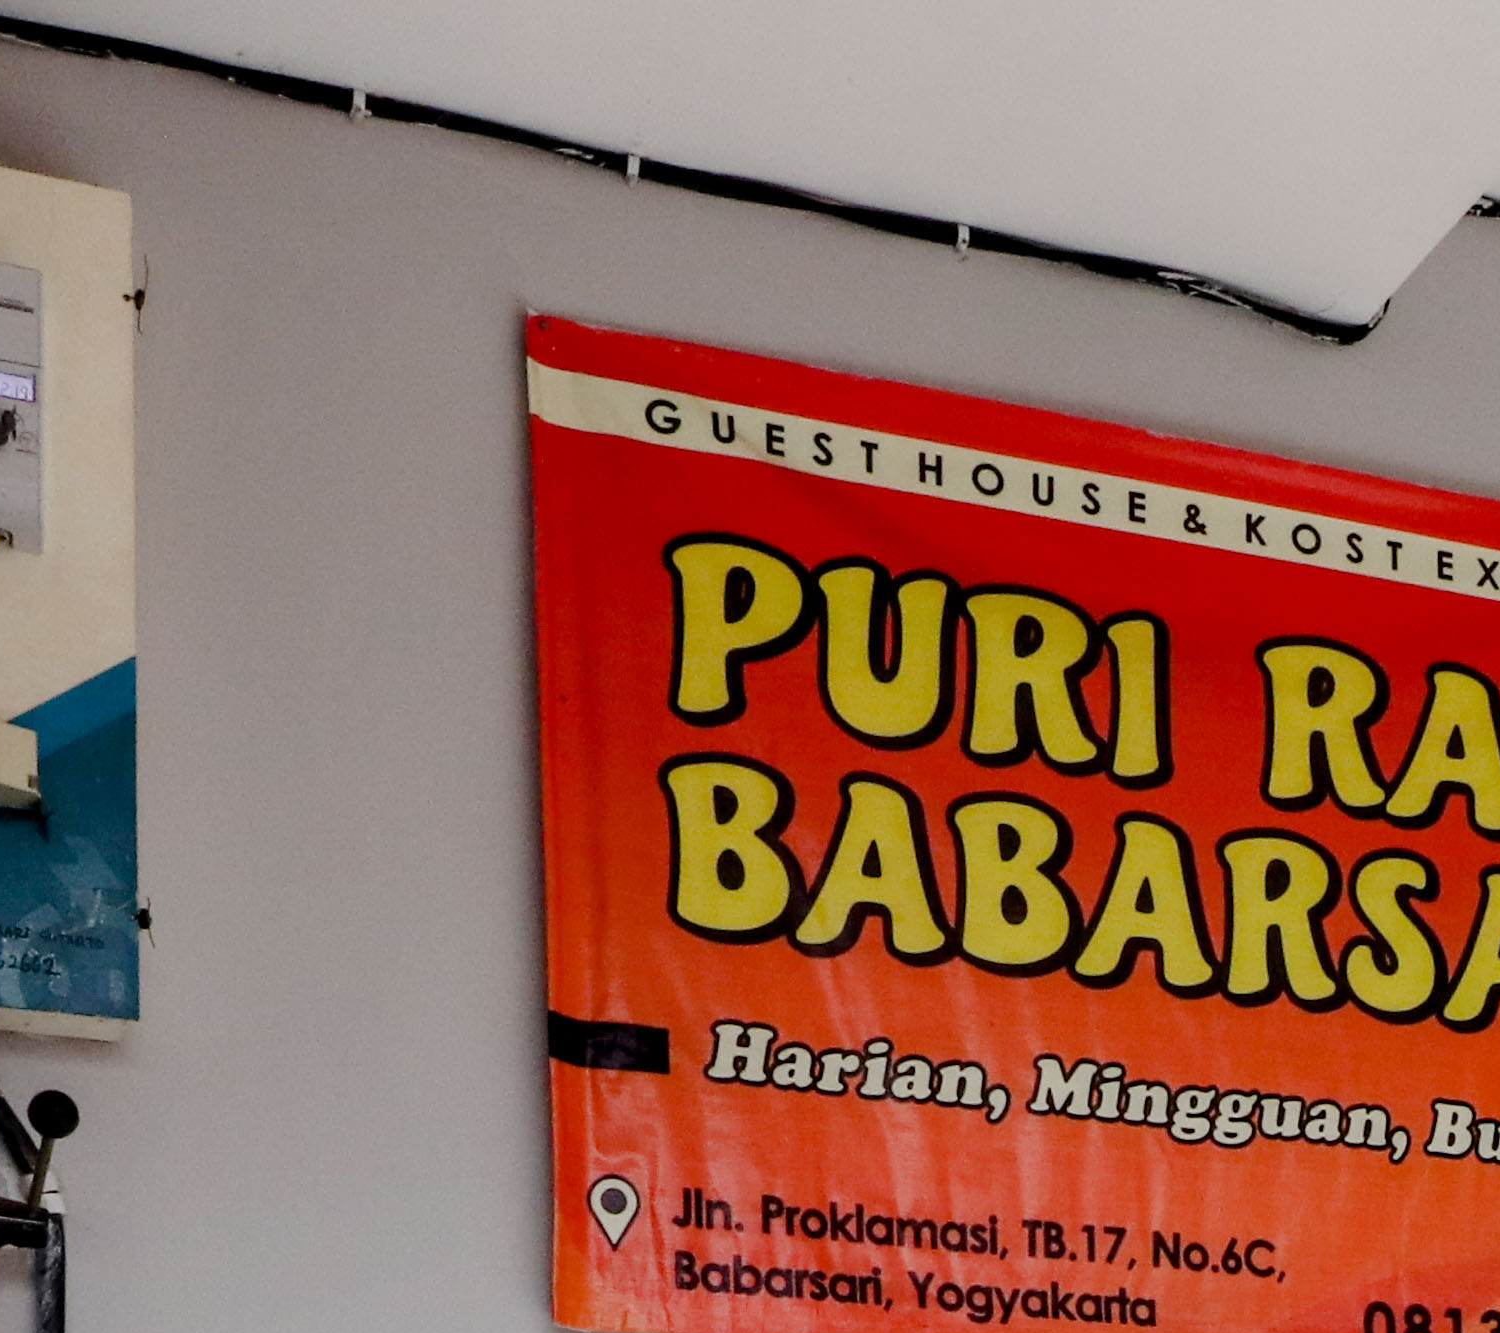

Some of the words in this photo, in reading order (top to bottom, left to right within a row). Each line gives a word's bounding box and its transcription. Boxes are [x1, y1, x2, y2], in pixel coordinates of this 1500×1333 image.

[645, 398, 879, 474] GUEST
[918, 452, 1147, 524] HOUSE
[1183, 503, 1207, 534] &
[1245, 513, 1403, 571] KOST
[662, 531, 1172, 790] PURI
[707, 1020, 1009, 1122] Harian,
[1029, 1052, 1410, 1163] Mingguan,
[672, 1188, 744, 1234] Jln.
[760, 1194, 1009, 1260] Proklamasi,
[1022, 1219, 1137, 1272] TB.17,
[1151, 1229, 1287, 1284] No.6C,
[673, 1250, 894, 1312] Babarsari,
[907, 1270, 1158, 1328] Yogyakarta
